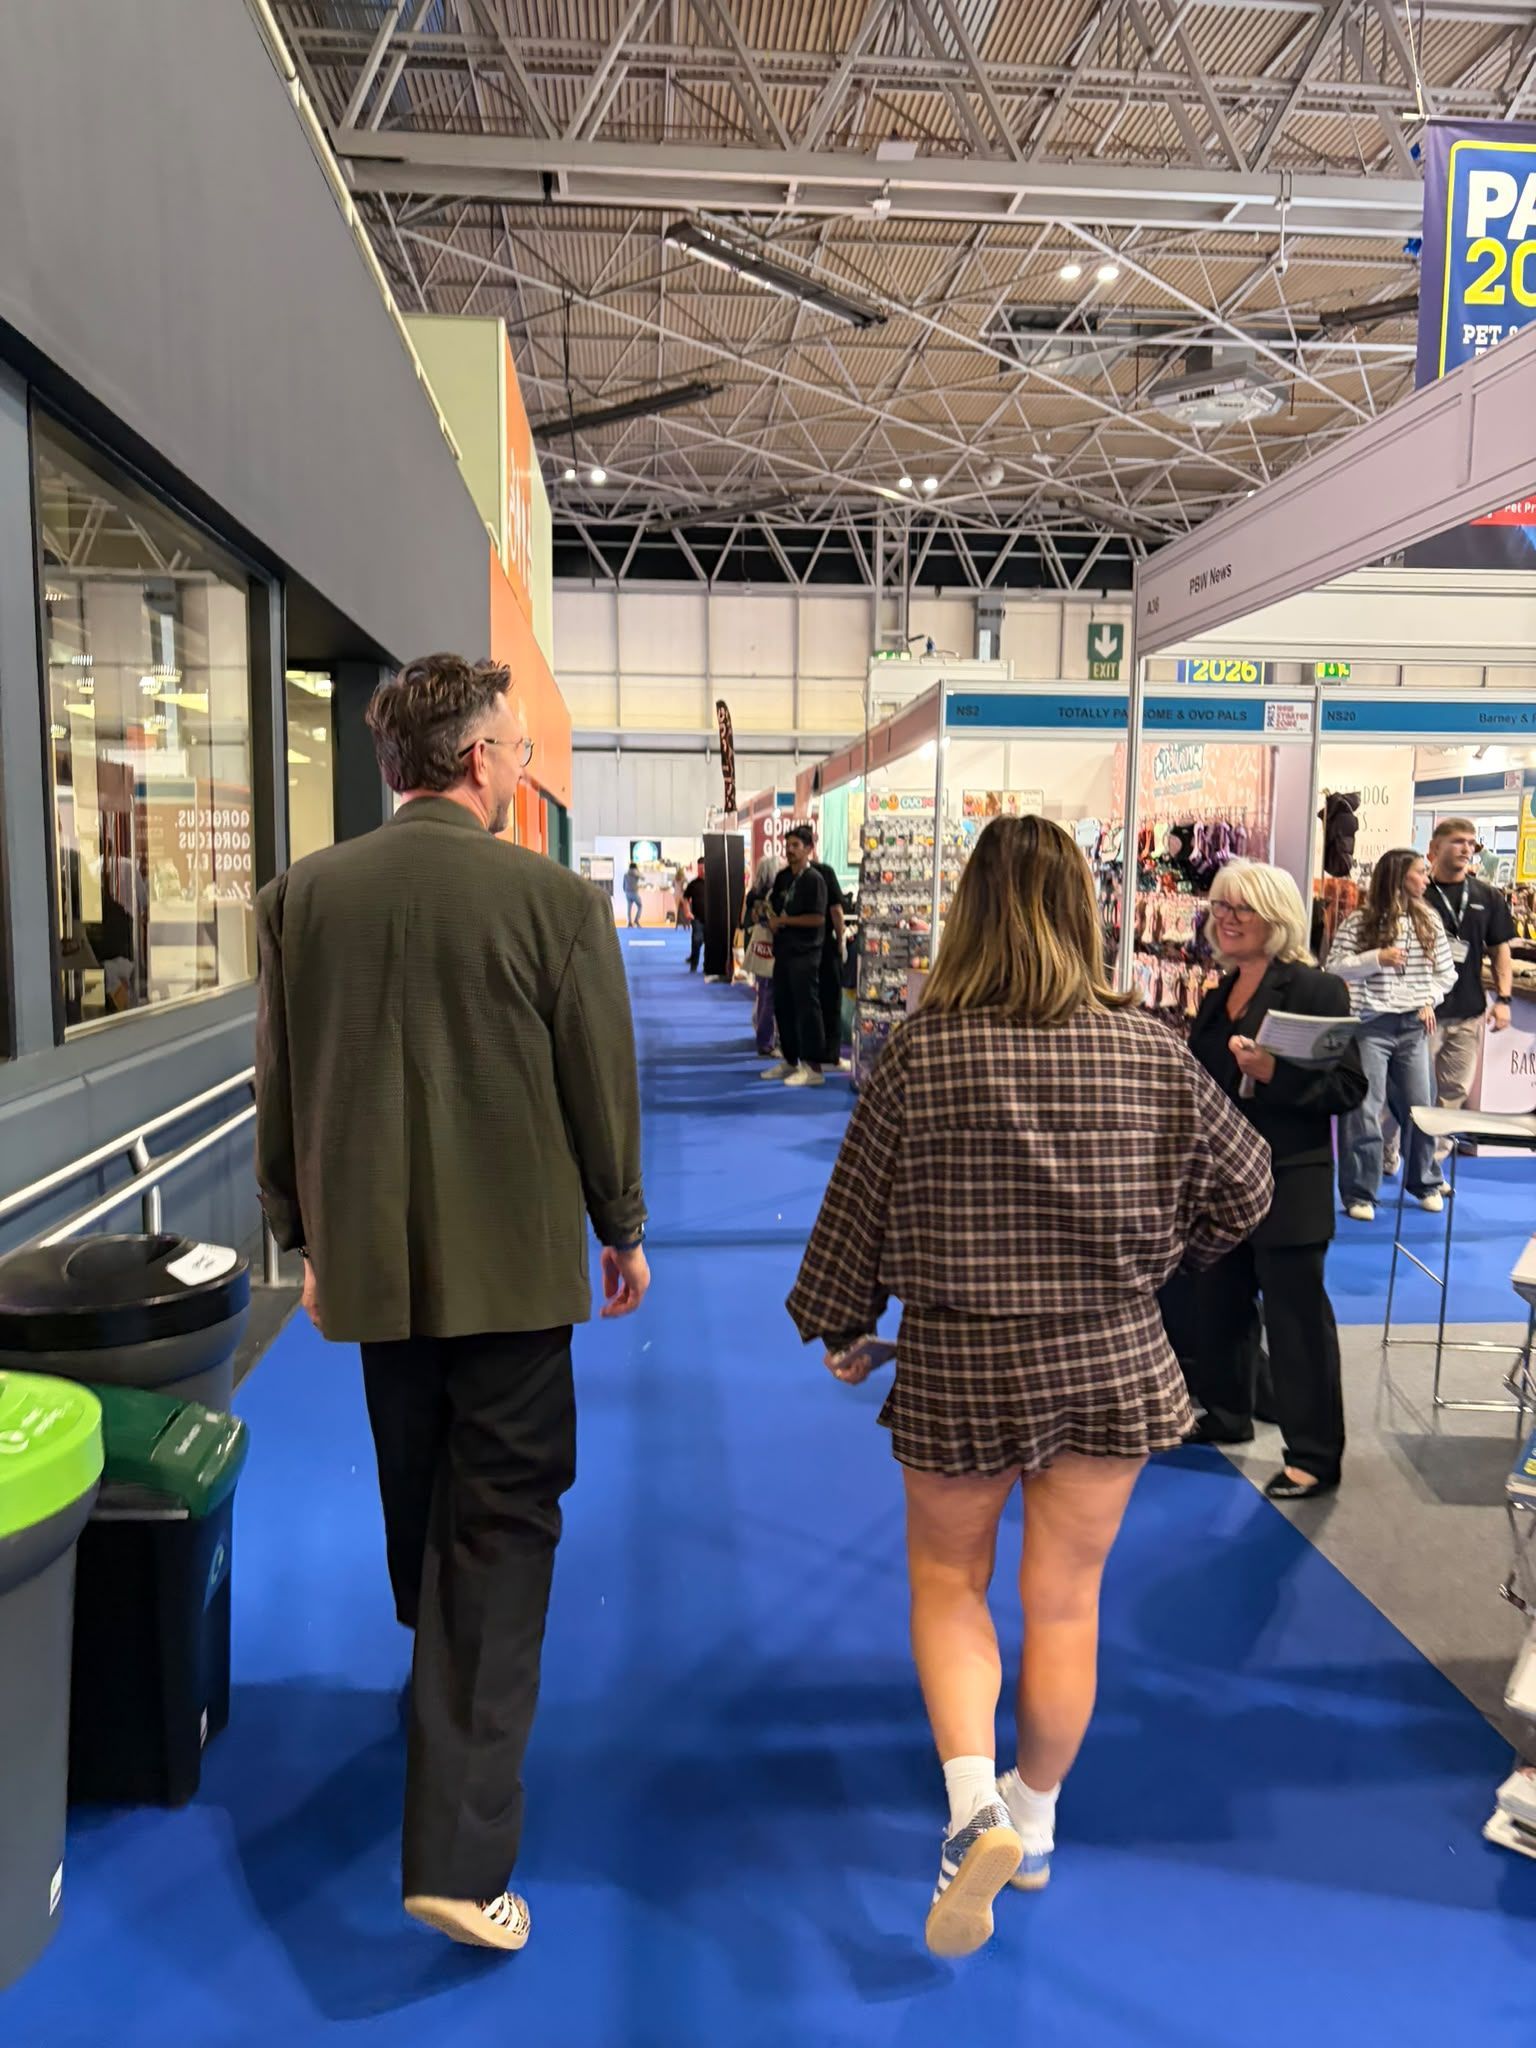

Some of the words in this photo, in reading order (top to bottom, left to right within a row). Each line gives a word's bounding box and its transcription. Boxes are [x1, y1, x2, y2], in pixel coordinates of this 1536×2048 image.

[1462, 323, 1503, 346] PET
[1189, 570, 1209, 596] PBW
[1209, 563, 1232, 586] News
[1093, 662, 1117, 678] EXIT
[1192, 659, 1258, 683] 2026
[956, 705, 980, 717] NS2
[1058, 706, 1110, 719] TOTALLY
[1176, 709, 1185, 720] &
[1188, 709, 1214, 720] OVO
[1216, 709, 1248, 721] PALS
[1327, 708, 1357, 721] NS20
[1479, 712, 1517, 725] Barney
[1520, 713, 1529, 723] &
[1363, 785, 1389, 806] DOG
[1510, 1049, 1536, 1075] BAR
